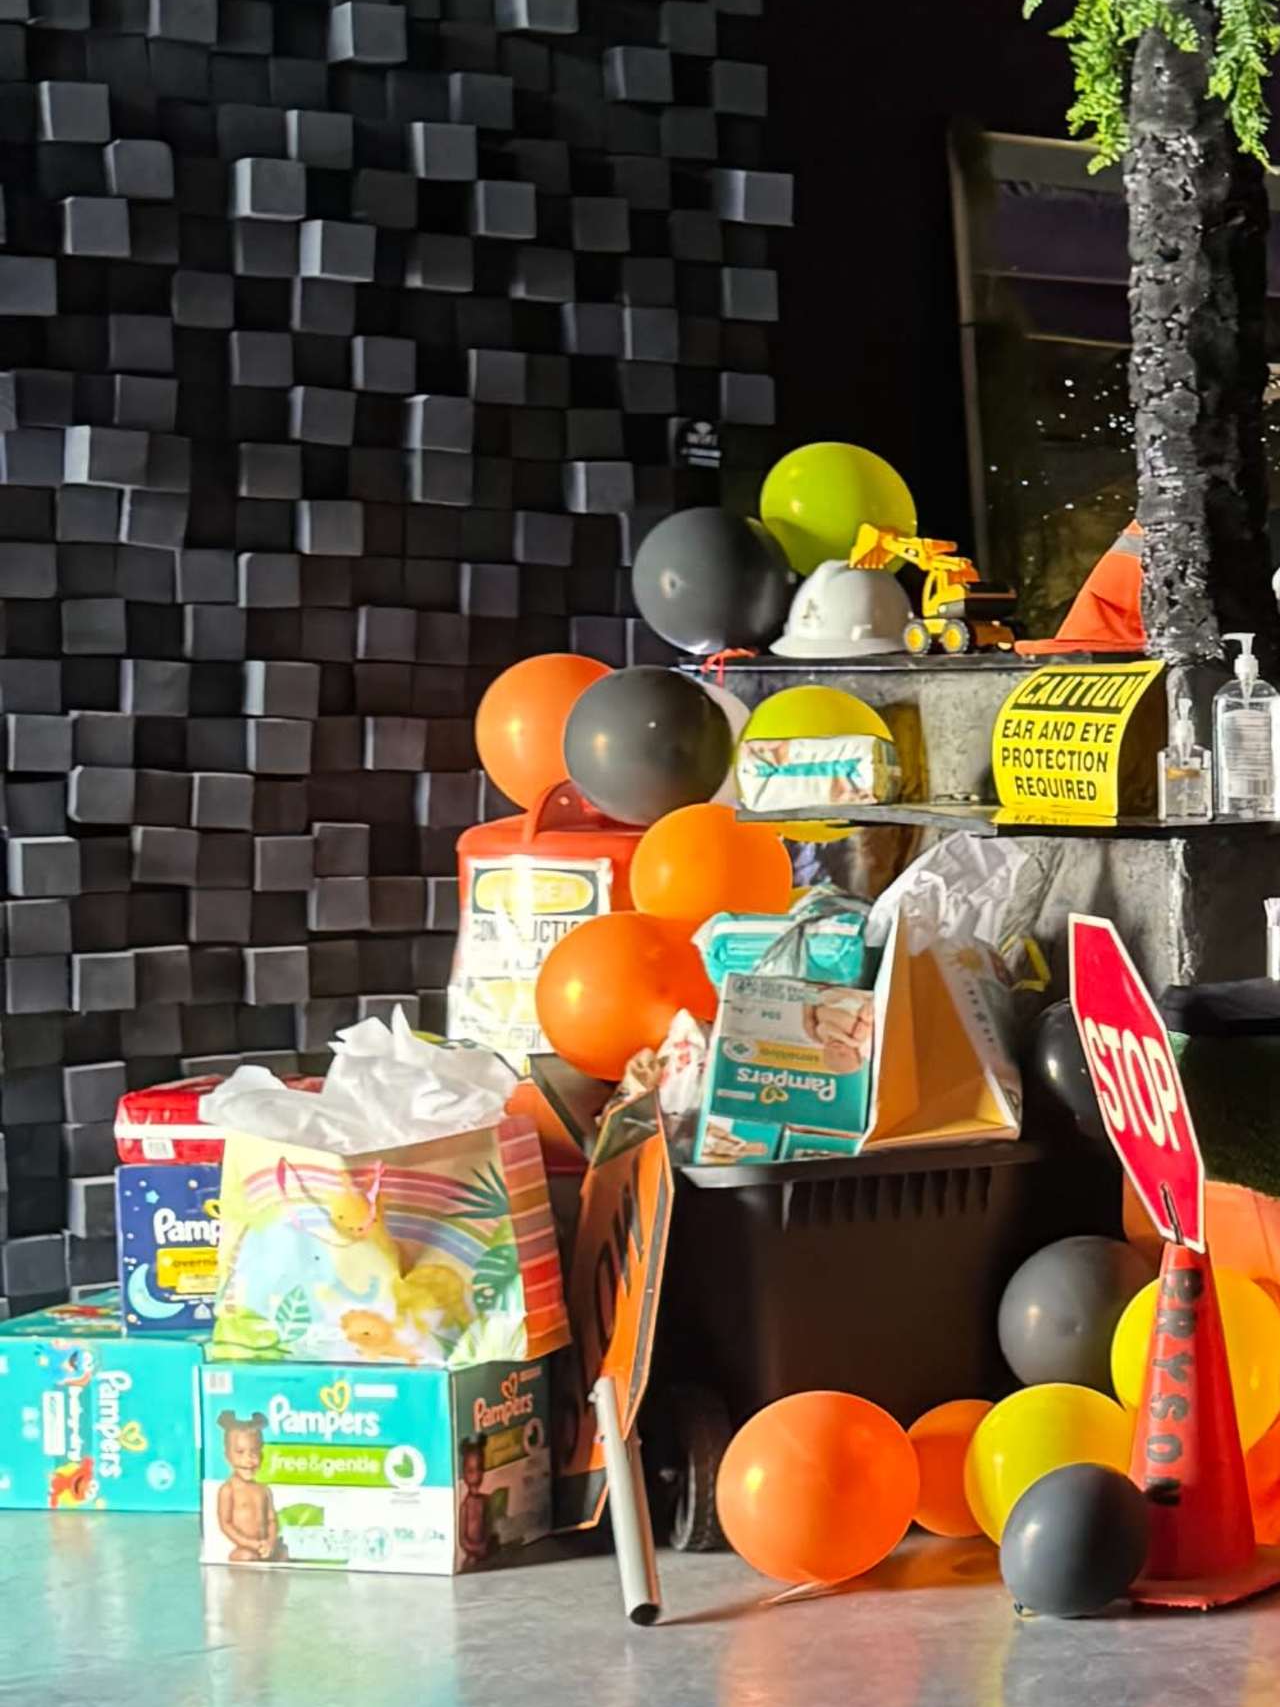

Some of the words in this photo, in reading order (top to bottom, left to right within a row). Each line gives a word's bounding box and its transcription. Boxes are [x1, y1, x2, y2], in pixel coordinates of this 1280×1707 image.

[1016, 676, 1145, 707] CAUTION
[1002, 719, 1035, 740] EAR
[1039, 721, 1076, 741] AND
[1080, 722, 1116, 743] EYE
[1002, 747, 1108, 773] PROTECTION
[1015, 776, 1097, 801] REQUIRED
[737, 1067, 837, 1102] Pampers
[1085, 1017, 1180, 1152] STOP
[153, 1208, 221, 1245] Pamp
[1145, 1268, 1205, 1507] BRYSON
[95, 1370, 133, 1479] Pampers
[269, 1393, 380, 1442] Pampers
[474, 1393, 534, 1433] Pampers
